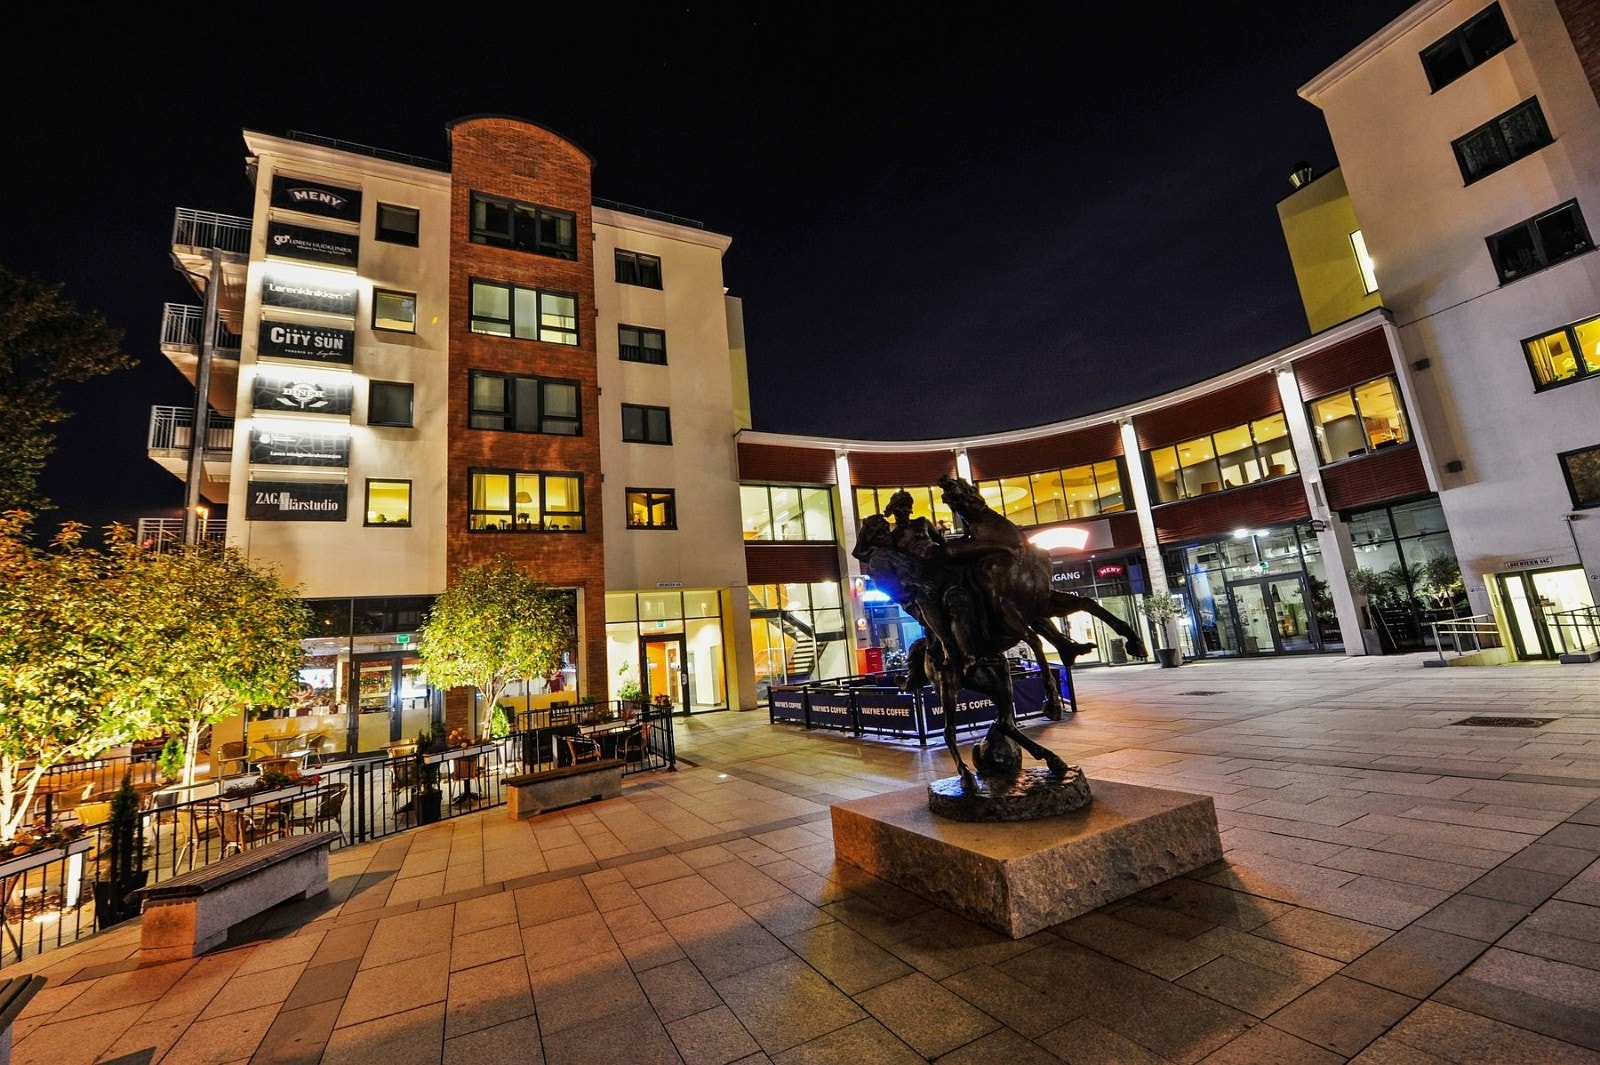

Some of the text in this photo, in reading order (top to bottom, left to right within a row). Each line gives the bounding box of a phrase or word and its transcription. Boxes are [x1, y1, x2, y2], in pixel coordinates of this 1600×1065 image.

[293, 191, 342, 206] MENY
[313, 336, 344, 349] SUN
[1051, 571, 1080, 581] GANG
[1100, 567, 1121, 575] MENY
[774, 700, 802, 710] WAYNE'S COFFEE
[811, 705, 847, 715] WAYNE'S COFFEE
[931, 699, 995, 716] WAE'S COFFE
[861, 706, 910, 717] WAYNE'S COFFEE
